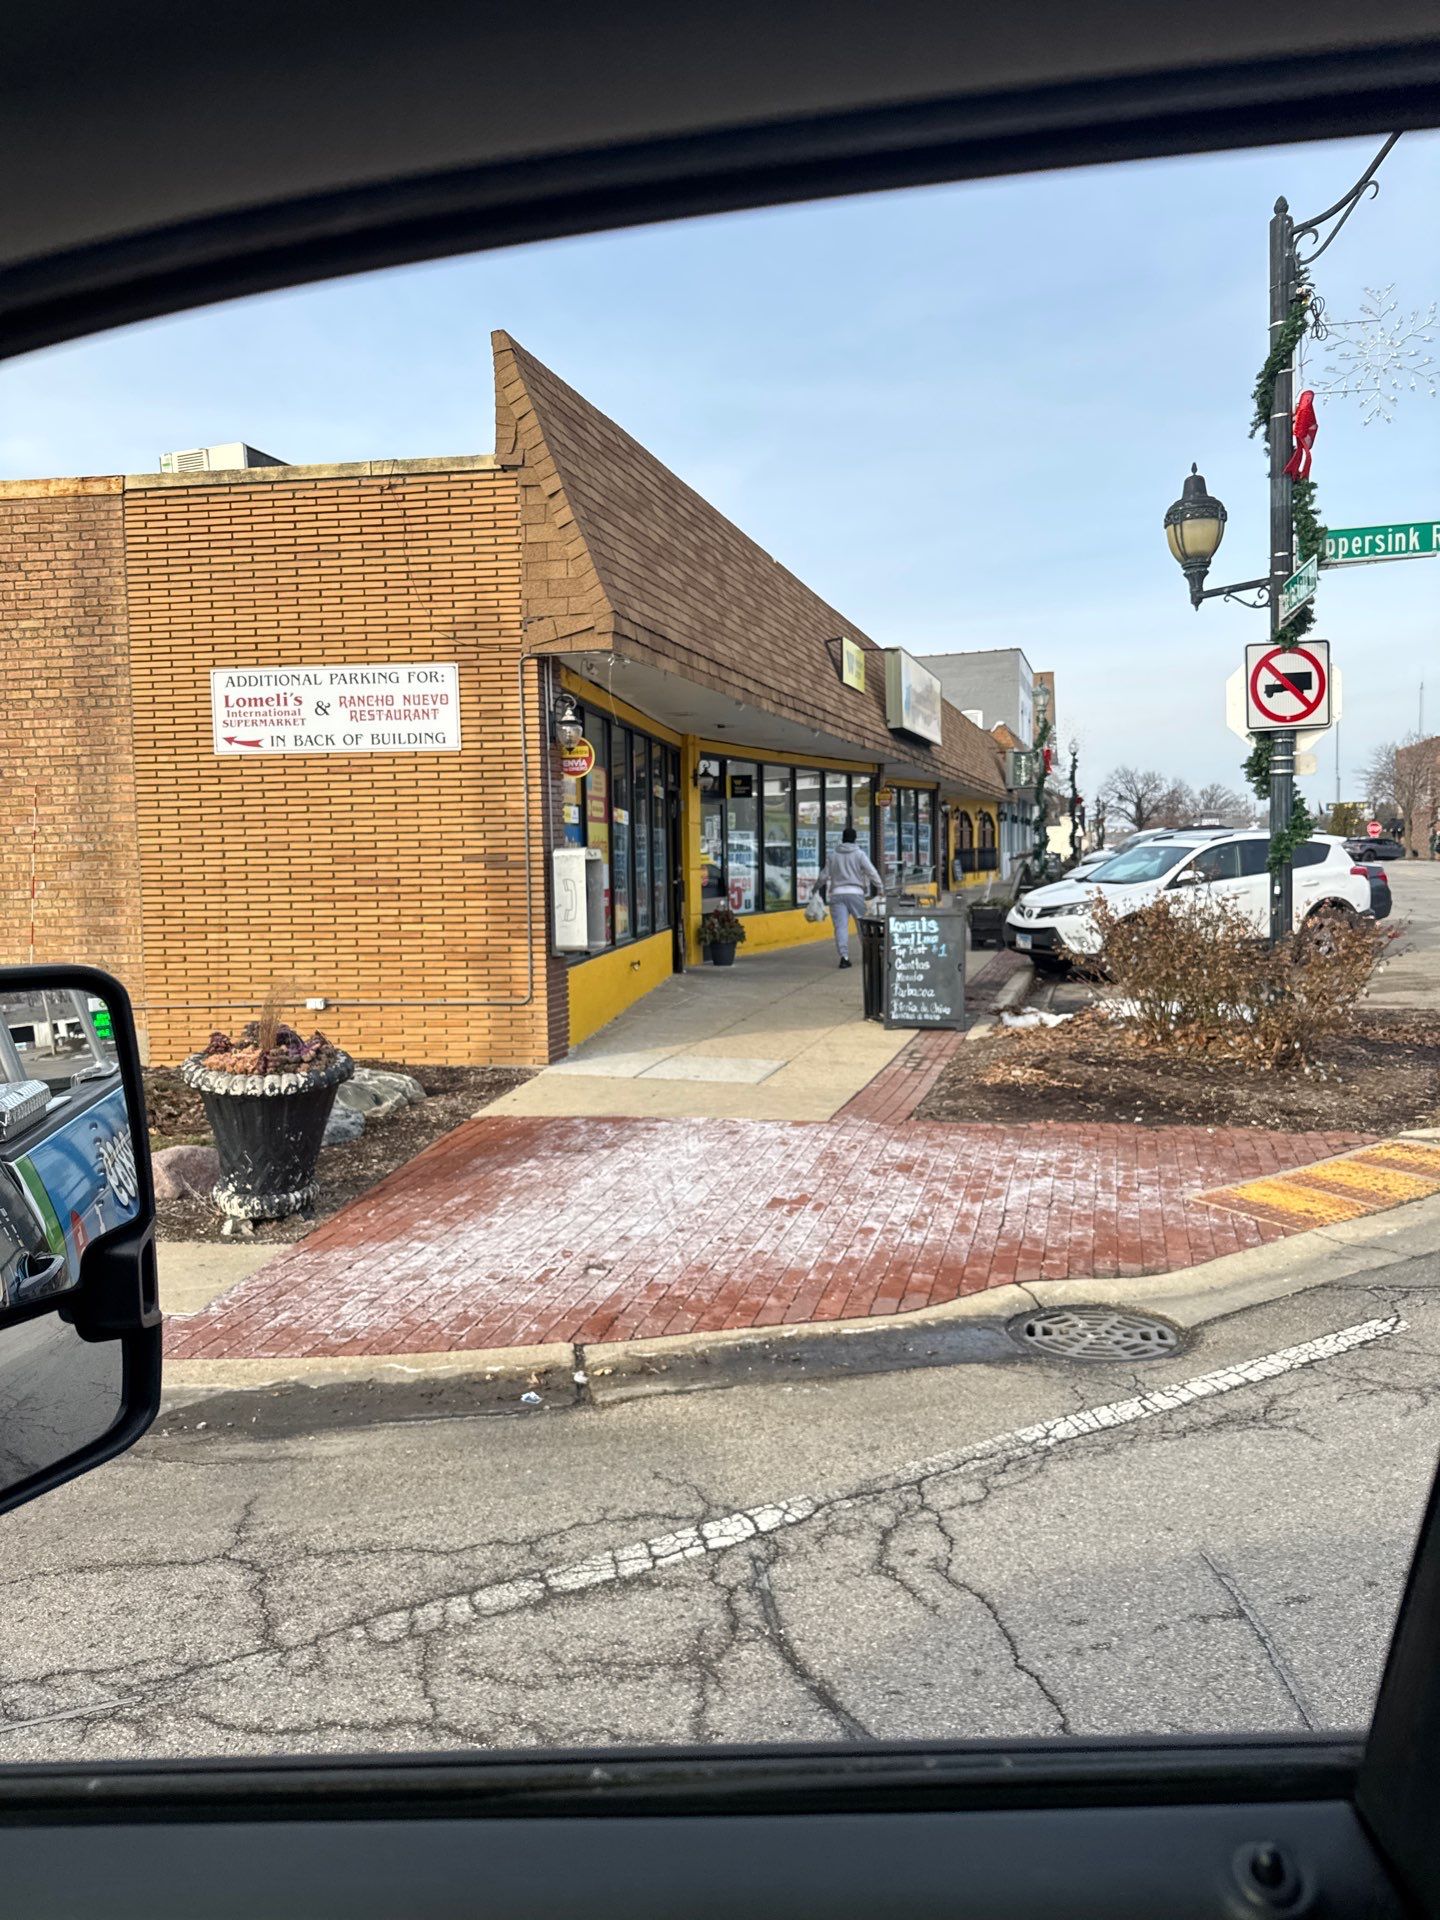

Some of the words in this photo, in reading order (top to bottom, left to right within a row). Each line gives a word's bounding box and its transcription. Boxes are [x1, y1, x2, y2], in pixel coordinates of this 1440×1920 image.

[1326, 526, 1420, 559] ppersink
[225, 672, 323, 688] ADDITIONAL
[330, 671, 400, 686] PARKING
[407, 670, 445, 684] FOR:
[223, 692, 303, 708] Lomeli's
[339, 694, 395, 709] RANCHO
[403, 693, 449, 706] NUEVO
[314, 700, 331, 716] &
[222, 718, 307, 728] SUPERMARKET
[226, 708, 302, 718] International
[349, 708, 440, 723] RESTAURANT
[270, 735, 286, 748] IN
[294, 734, 335, 747] BACK
[342, 733, 364, 746] OF
[371, 732, 447, 746] BUILDING
[796, 838, 817, 849] TACO
